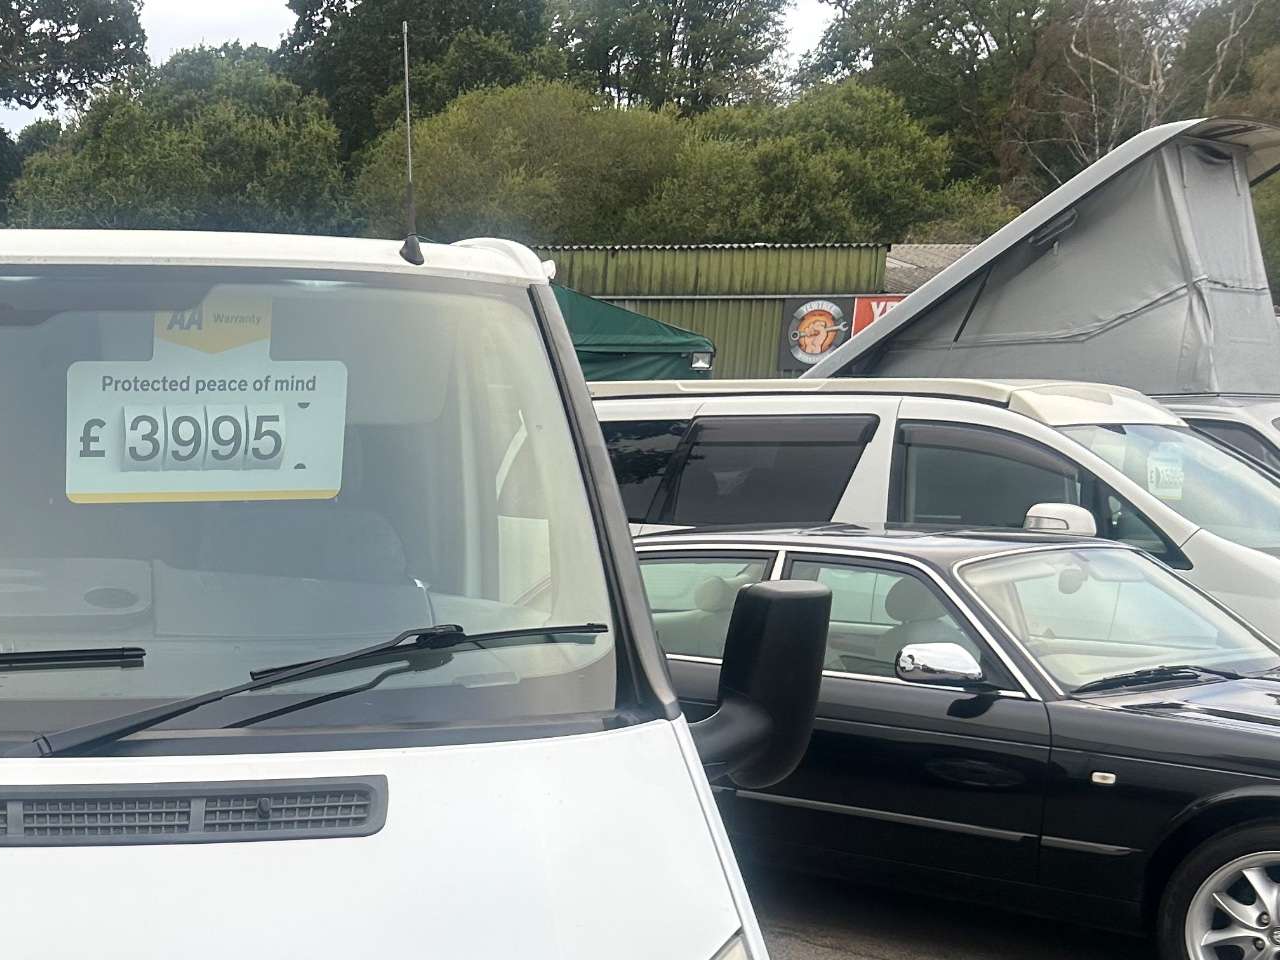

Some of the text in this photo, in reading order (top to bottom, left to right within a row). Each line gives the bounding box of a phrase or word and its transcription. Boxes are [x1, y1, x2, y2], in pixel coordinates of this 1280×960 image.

[213, 312, 262, 325] Warranty
[101, 375, 317, 394] Protected peace of mind
[128, 414, 283, 462] 3995
